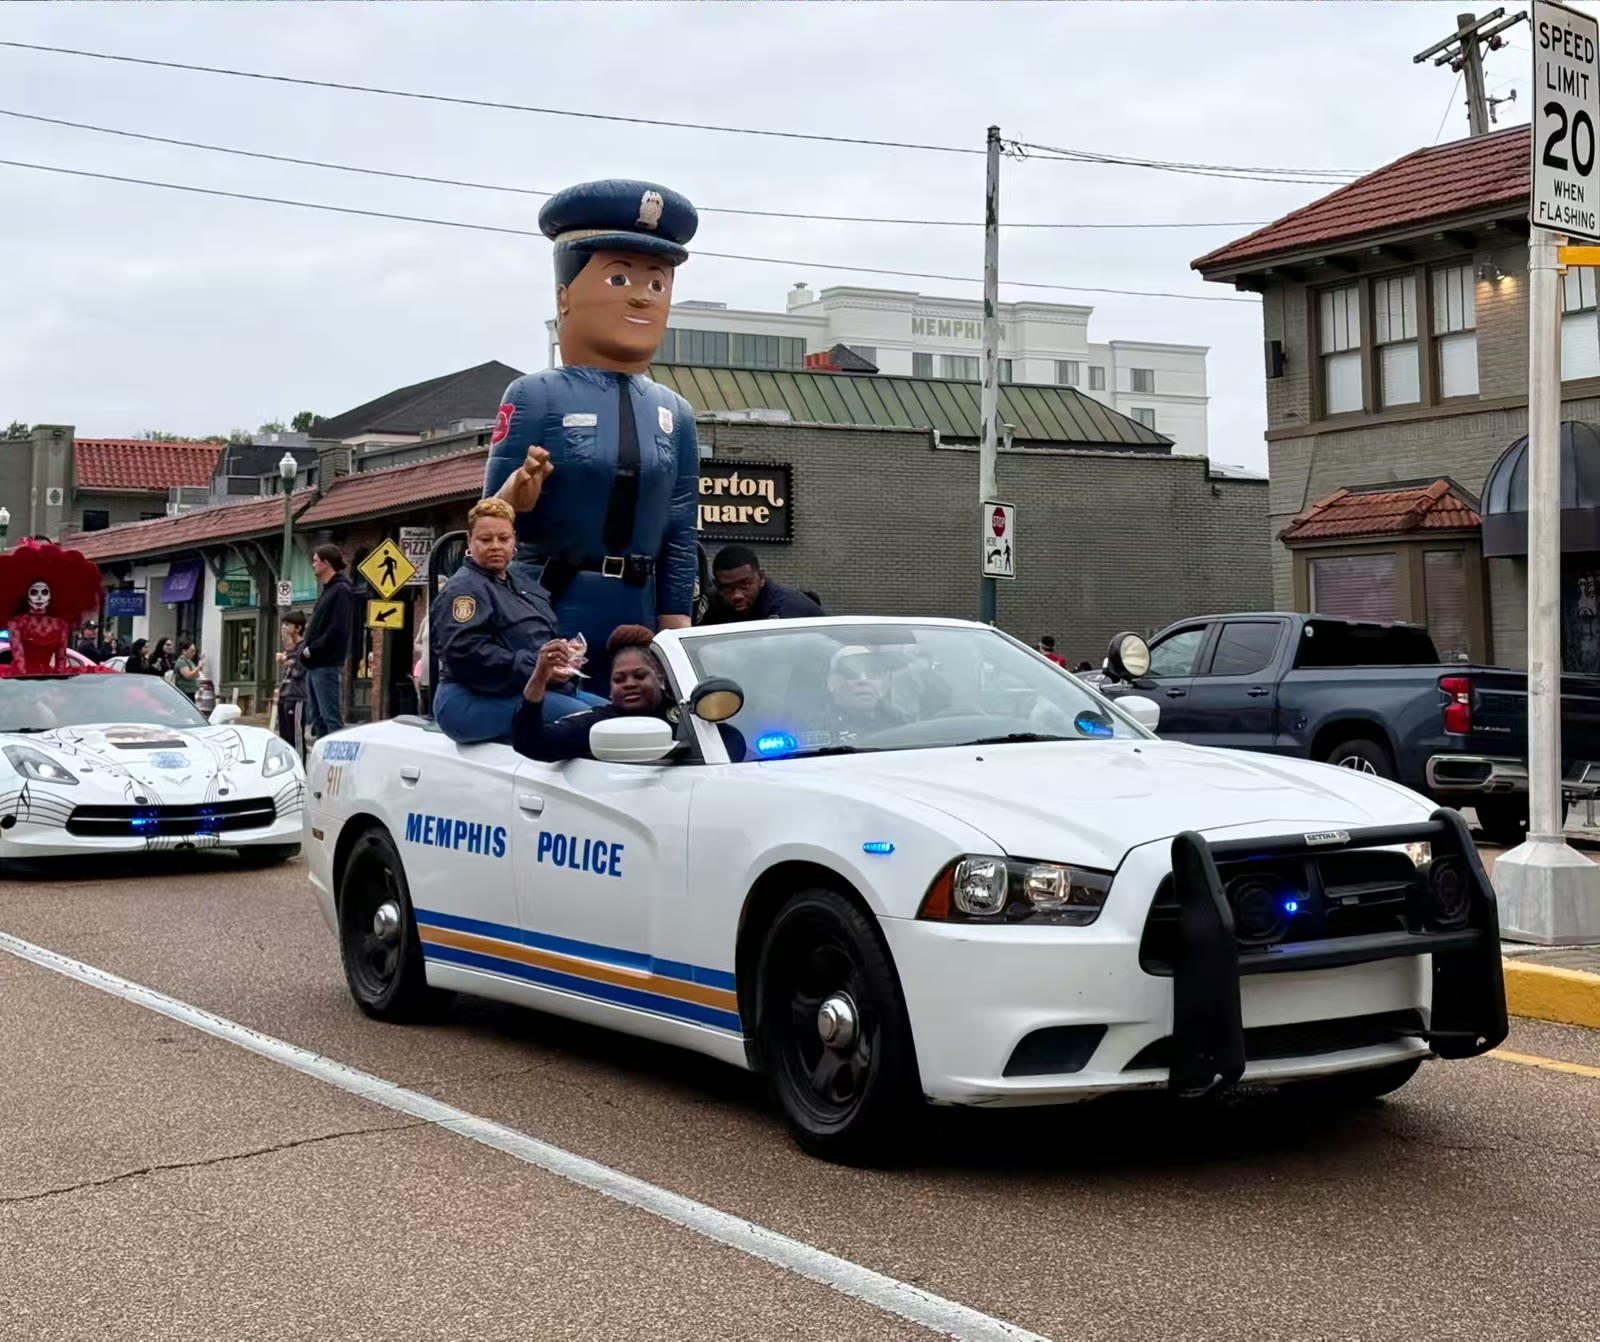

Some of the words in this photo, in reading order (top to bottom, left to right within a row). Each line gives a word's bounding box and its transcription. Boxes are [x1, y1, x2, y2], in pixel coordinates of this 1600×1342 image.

[1539, 21, 1595, 65] SPEED
[1546, 61, 1590, 101] LIMIT
[1542, 101, 1596, 177] 20
[1553, 179, 1585, 203] WHEN
[1539, 201, 1596, 230] FLASHING
[911, 317, 1006, 341] MEMPHIN
[698, 471, 784, 507] erton
[697, 504, 770, 531] uare
[992, 515, 1006, 528] STOP
[402, 540, 433, 556] PIZZA
[322, 740, 361, 762] EMERGENCY
[327, 765, 343, 796] 911
[405, 812, 507, 858] MEMPHIS
[537, 831, 624, 878] POLICE
